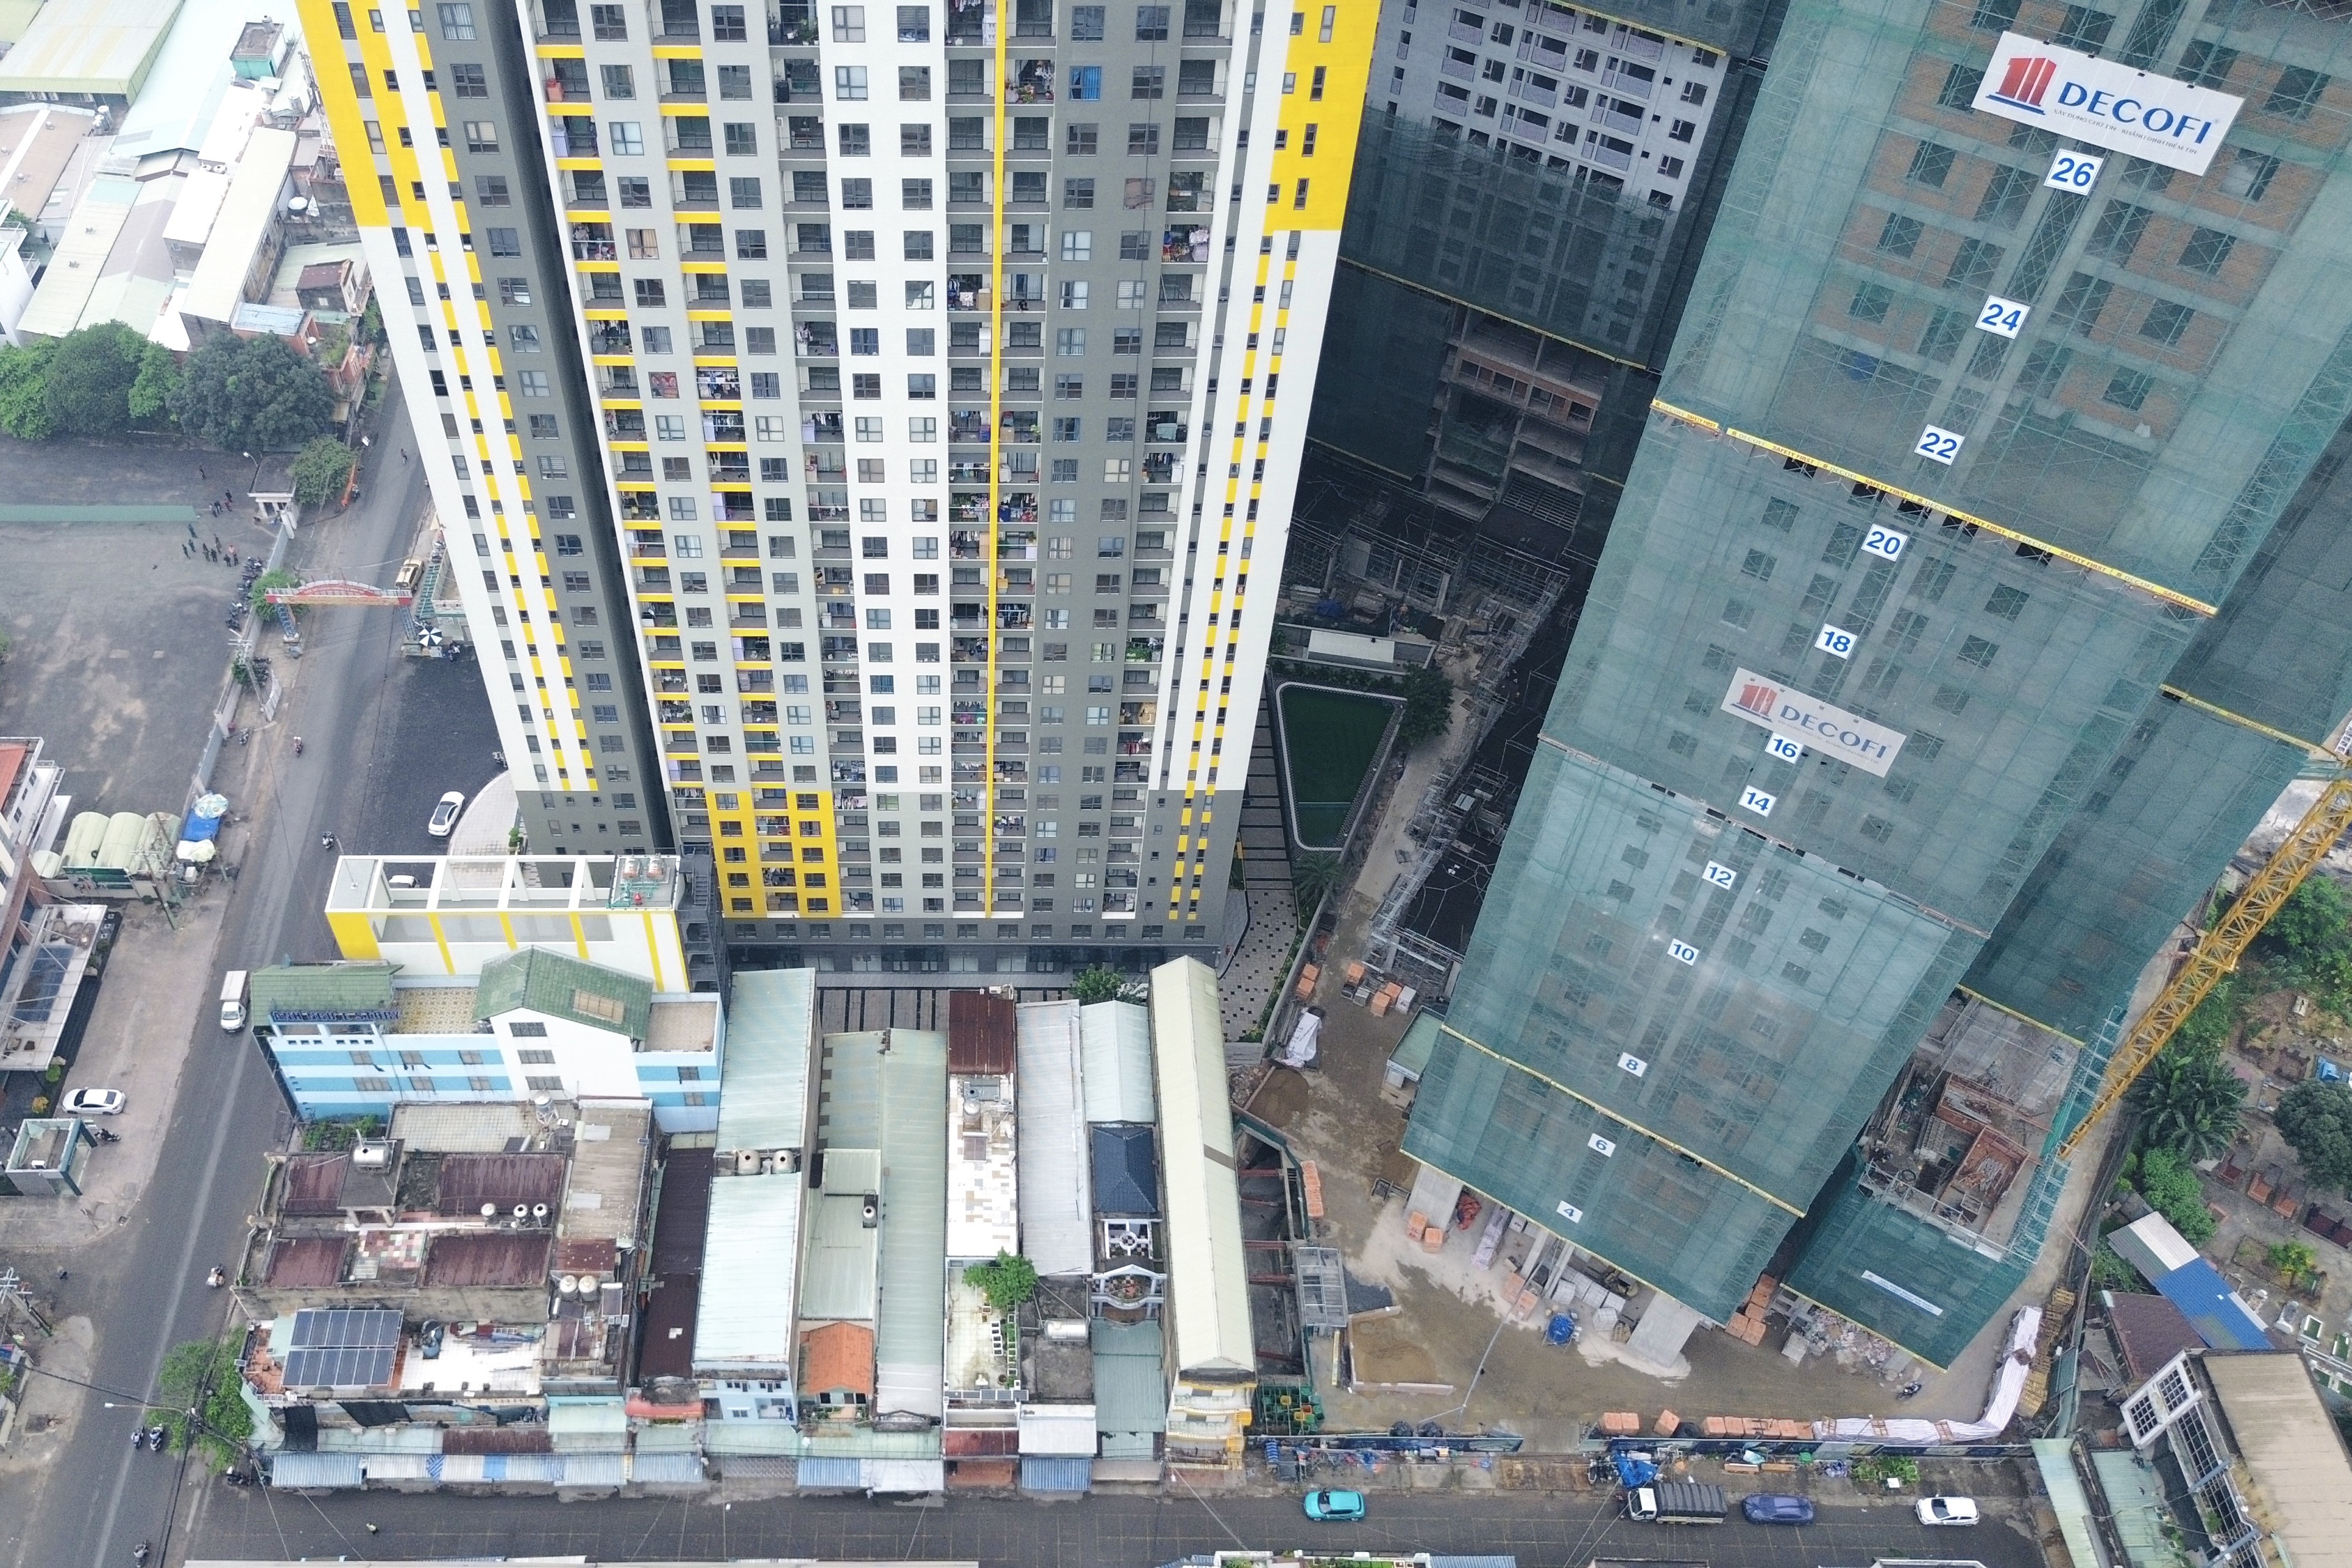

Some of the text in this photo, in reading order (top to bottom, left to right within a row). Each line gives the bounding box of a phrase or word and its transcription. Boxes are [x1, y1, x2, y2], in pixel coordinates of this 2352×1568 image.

[2057, 82, 2212, 144] DECOFI
[2051, 157, 2094, 187] 26
[1981, 303, 2022, 331] 24
[1772, 445, 1796, 457] SAFETY
[1796, 454, 1814, 464] FIRST
[1920, 432, 1958, 459] 22
[1864, 479, 1888, 490] SAFETY
[1889, 488, 1909, 498] FIRST
[1961, 514, 1985, 527] SAFETY
[1986, 524, 2006, 535] FIRST
[1866, 530, 1900, 555] 20
[2059, 551, 2086, 564] SAFETY
[2086, 561, 2106, 572] FIRST
[2163, 590, 2189, 603] SAFETY
[2190, 601, 2211, 610] FIRST
[1824, 631, 1851, 653] 18
[1780, 705, 1887, 759] DECOFI
[1773, 738, 1798, 758] 16
[1746, 792, 1771, 811] 14
[1709, 866, 1732, 886] 12
[1673, 944, 1694, 961] 10
[272, 1010, 302, 1022] ANH
[355, 1010, 400, 1021] STORY
[1625, 1059, 1638, 1071] 8
[1595, 1139, 1608, 1151] 6
[1563, 1208, 1575, 1217] 4
